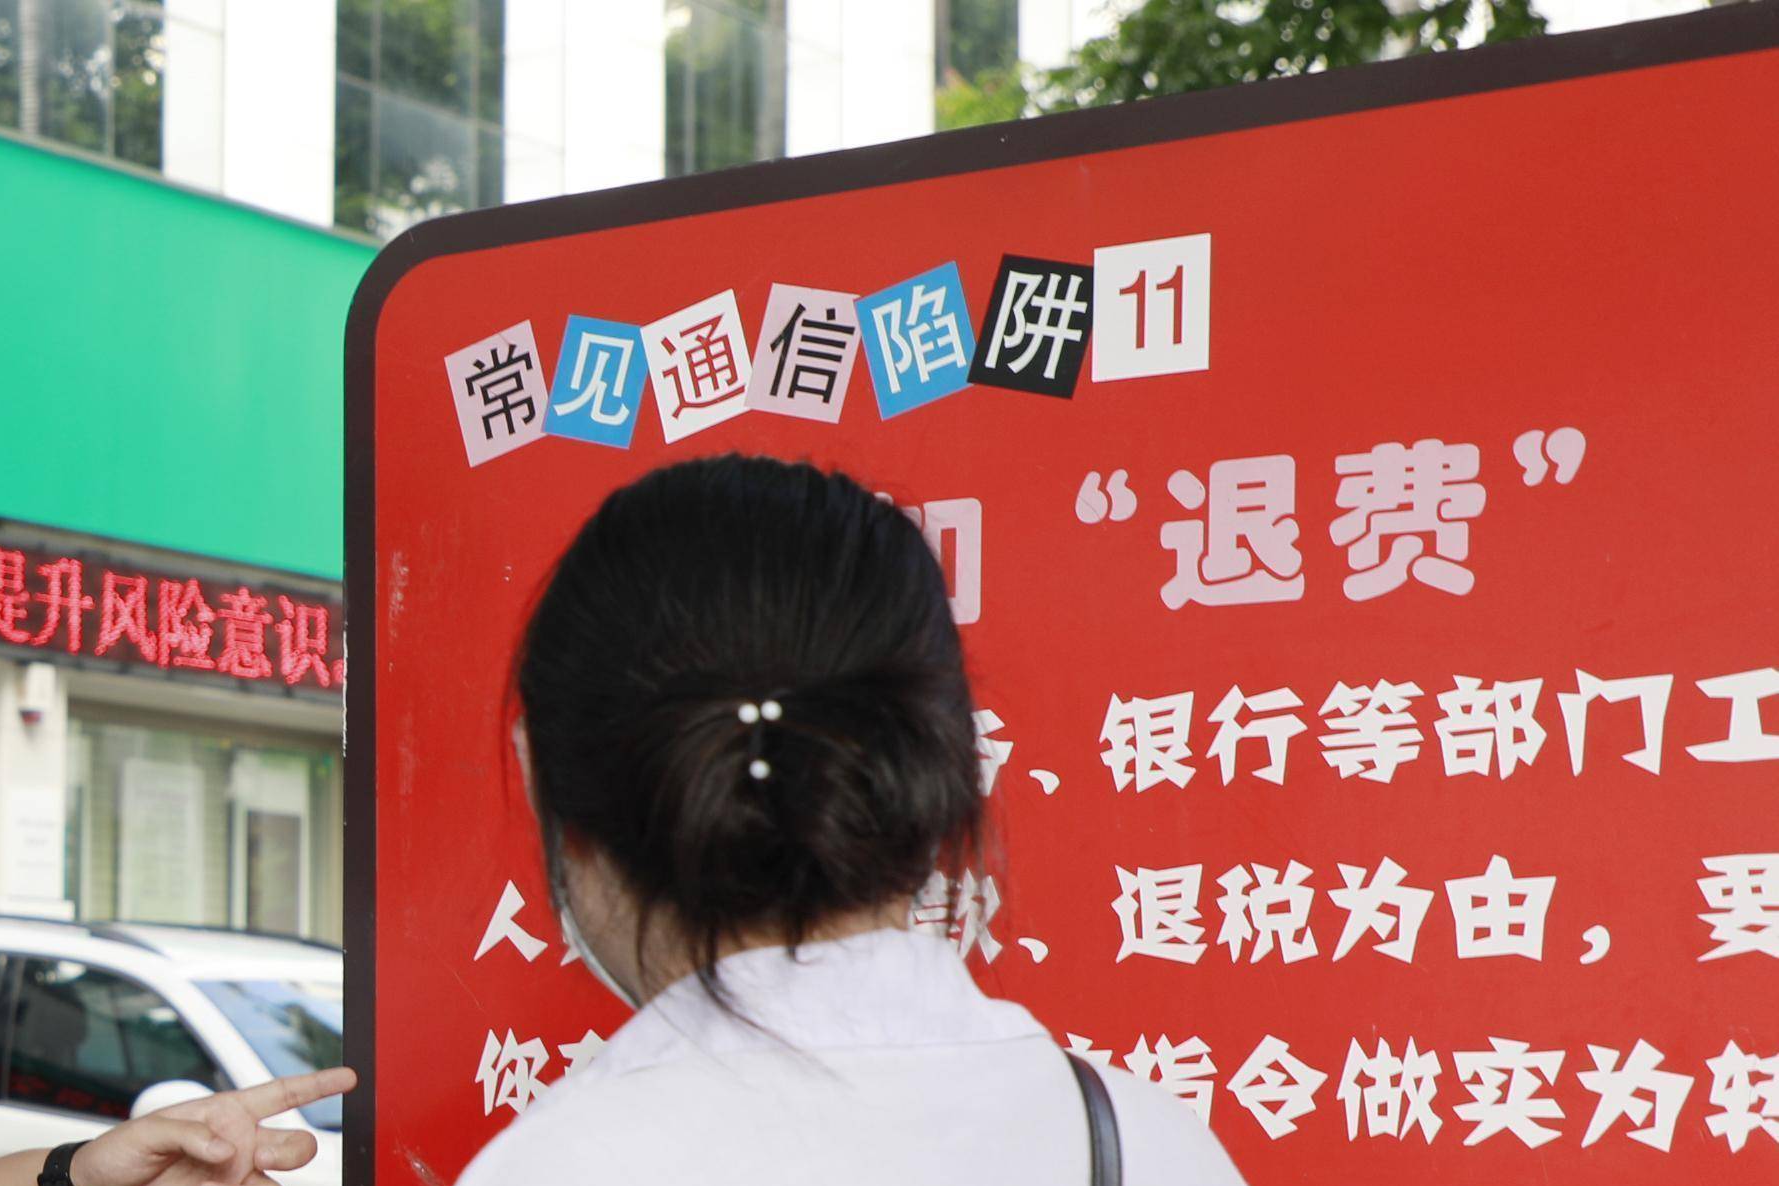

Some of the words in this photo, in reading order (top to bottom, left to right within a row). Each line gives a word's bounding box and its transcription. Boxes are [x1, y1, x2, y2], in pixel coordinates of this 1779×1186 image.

[1064, 1032, 1779, 1154] 指令做实为转
